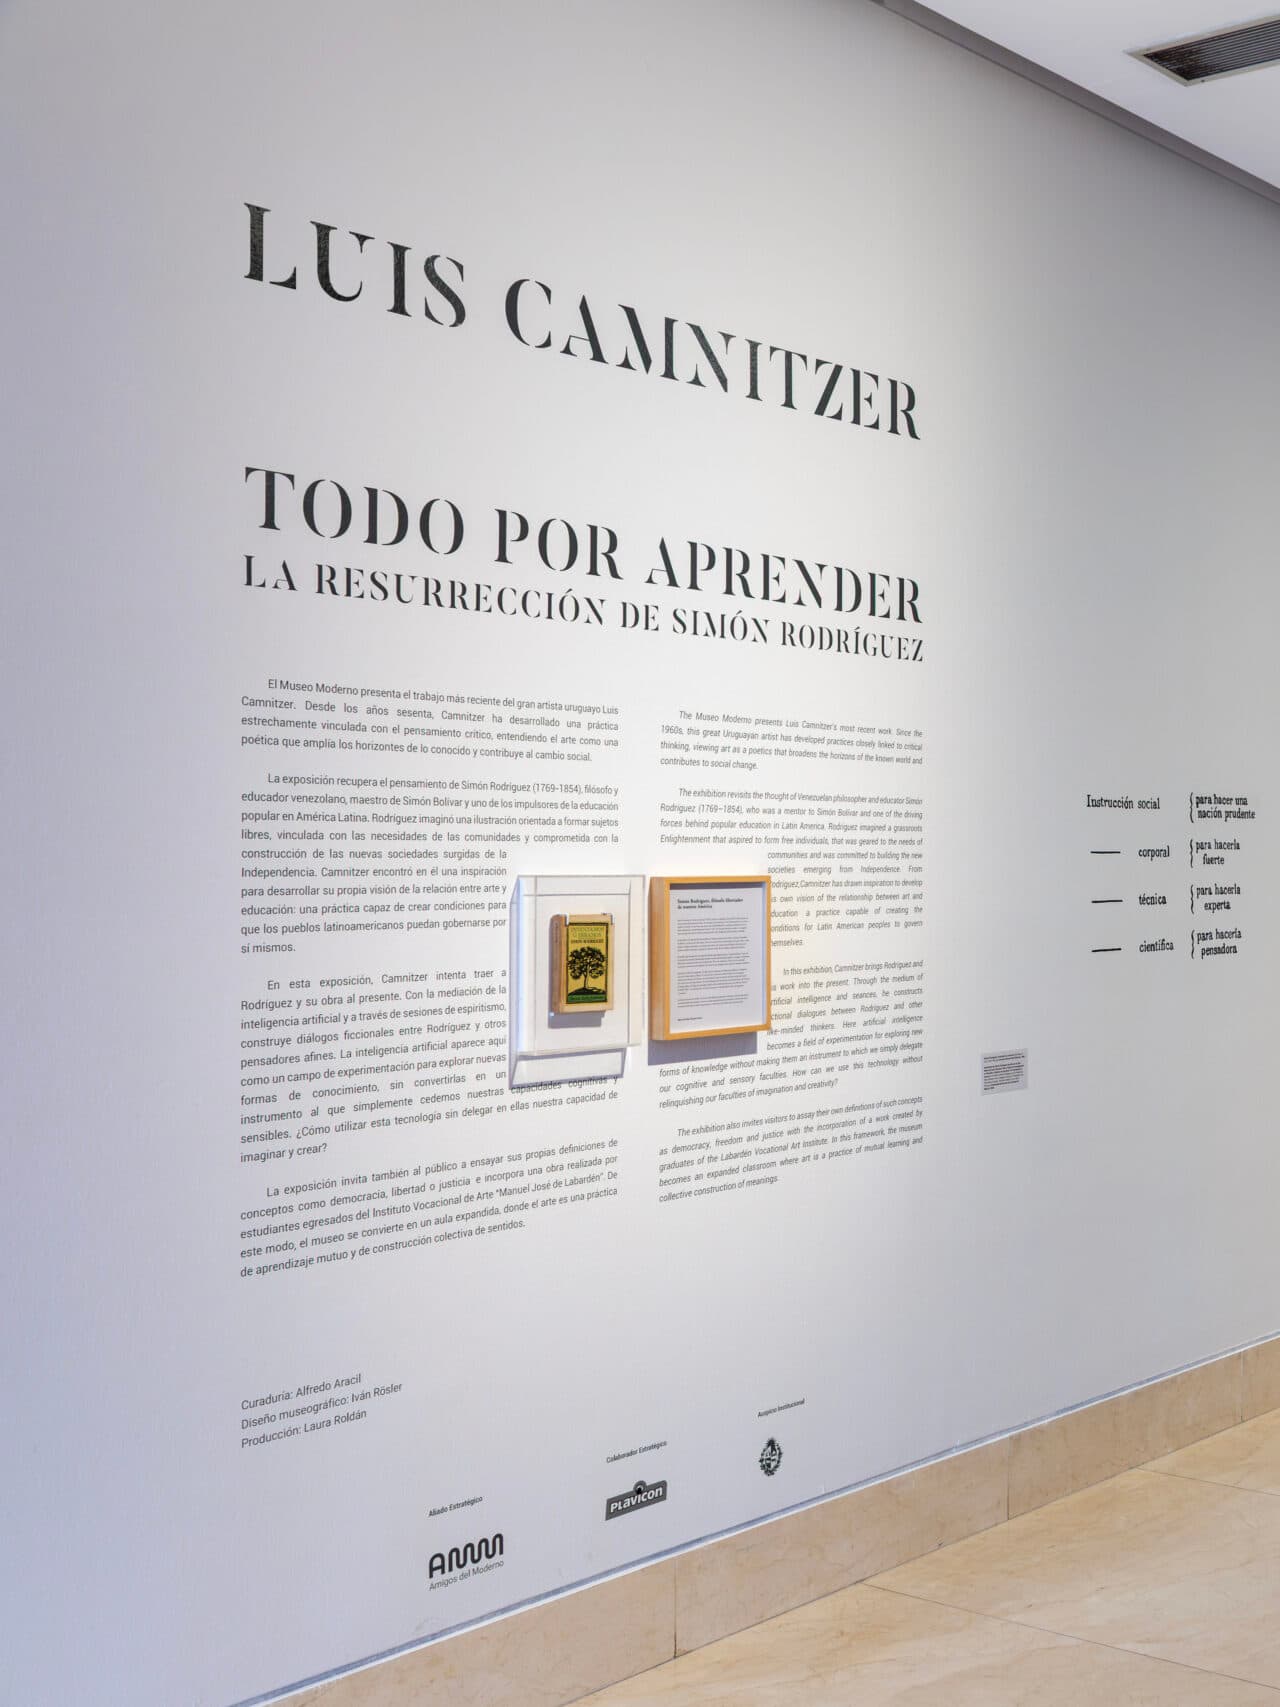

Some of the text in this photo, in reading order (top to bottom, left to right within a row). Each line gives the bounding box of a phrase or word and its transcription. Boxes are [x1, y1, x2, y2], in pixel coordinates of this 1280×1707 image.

[244, 203, 920, 440] LUIS CAMNITZER
[245, 467, 922, 624] TODO POR APRENDER
[245, 555, 923, 662] LA RESURRECCIÓN DE SIMÓN RODRÍGUEZ
[268, 678, 619, 715] El Museo Moderno presenta el trabajo más reciente del gran artista uruguayo Luis
[241, 695, 296, 710] Camnitzer.
[305, 700, 336, 712] Desde
[344, 702, 358, 714] los
[366, 704, 389, 716] años
[441, 710, 485, 722] Camnitzer
[492, 713, 503, 723] ha
[509, 715, 560, 727] desarrollado
[566, 720, 581, 729] una
[587, 721, 619, 731] práctica
[679, 710, 693, 720] The
[695, 712, 720, 722] Museo
[722, 714, 752, 724] Moderno
[754, 718, 783, 727] presents
[785, 720, 799, 728] Luis
[857, 726, 876, 734] recent
[660, 757, 700, 767] contributes
[702, 759, 710, 767] to
[710, 759, 731, 768] social
[1086, 794, 1160, 810] Instrucción social
[1195, 794, 1248, 808] para hacer una
[1198, 807, 1256, 821] nación prudente
[1138, 846, 1170, 861] corporal
[1195, 839, 1240, 853] para hacerla
[241, 848, 507, 861] construcción de las nuevas sociedades surgidas de la
[1203, 853, 1225, 865] fuerte
[767, 865, 795, 874] societies
[803, 866, 832, 876] emerging
[839, 865, 853, 873] from
[908, 865, 923, 873] From
[1196, 884, 1241, 898] para hacerla
[1138, 893, 1167, 906] técnica
[1204, 900, 1231, 914] experta
[1197, 929, 1242, 943] para hacerla
[1201, 944, 1238, 959] pensadora
[659, 1078, 838, 1109] relinquishing our faculties of imagination and creativity?
[240, 1142, 327, 1163] imaginar y crear?
[659, 1190, 693, 1203] collective
[693, 1183, 737, 1196] construction
[737, 1179, 745, 1189] of
[240, 1266, 253, 1278] de
[256, 1256, 315, 1276] aprendizaje
[316, 1251, 349, 1264] mutuo
[350, 1250, 357, 1260] y
[358, 1246, 370, 1256] de
[372, 1235, 432, 1254] construcción
[434, 1229, 473, 1243] colectiva
[475, 1226, 486, 1235] de
[295, 1381, 332, 1398] Alfredo
[333, 1373, 361, 1389] Aracil
[241, 1413, 277, 1430] Diseño
[279, 1396, 349, 1421] museográfico:
[351, 1390, 371, 1403] Iván
[241, 1410, 367, 1449] Producción: Laura Roldán
[429, 1506, 448, 1517] Aliado
[429, 1560, 504, 1591] Amigos del Moderno
